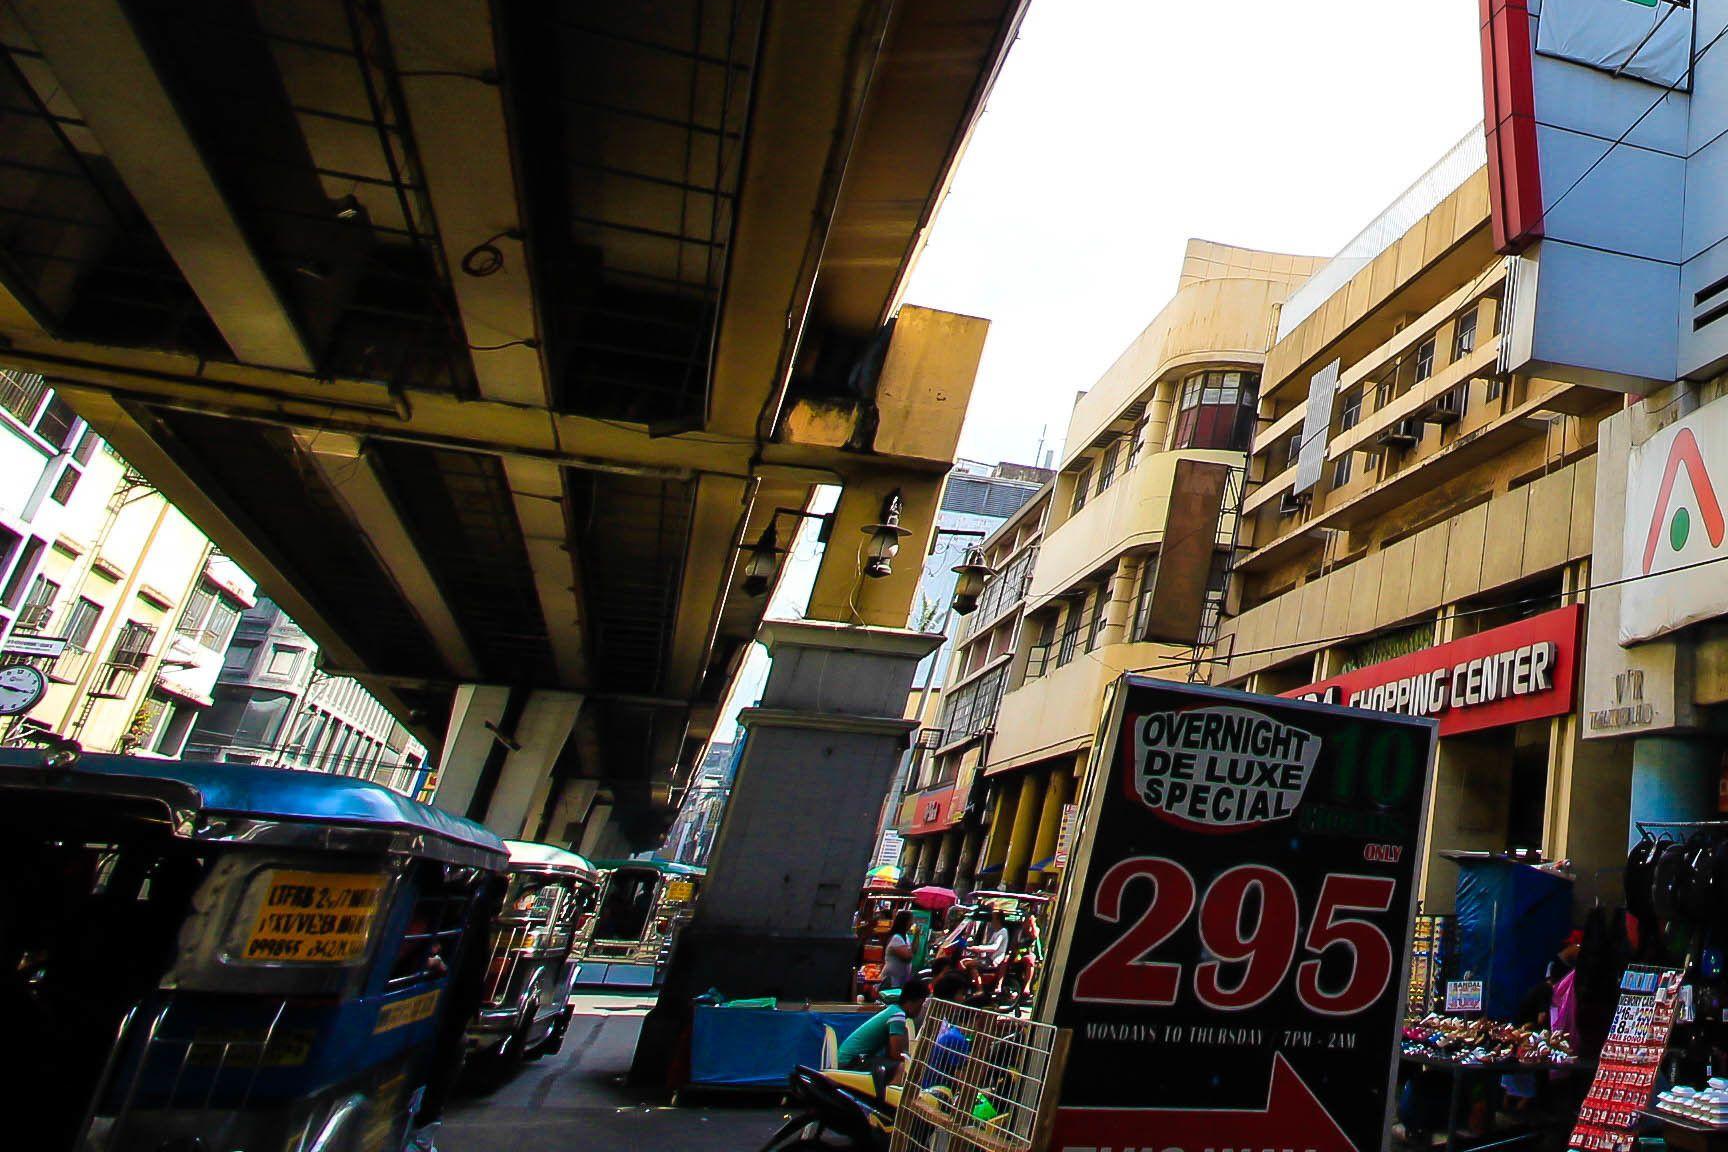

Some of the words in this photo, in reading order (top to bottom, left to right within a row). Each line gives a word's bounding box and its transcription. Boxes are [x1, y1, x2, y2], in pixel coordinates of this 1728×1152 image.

[1450, 641, 1553, 708] CENTER
[1143, 713, 1310, 762] OVERNIGHT
[1143, 749, 1197, 780] DE
[1205, 756, 1304, 791] LUXE
[1144, 778, 1291, 822] SPECIAL
[1364, 843, 1402, 862] ONLY
[1073, 855, 1396, 1016] 295
[1086, 1023, 1156, 1041] MONDAYS
[1164, 1025, 1182, 1043] TO
[1190, 1026, 1263, 1045] THURSDAY
[1283, 1030, 1312, 1047] 7PM
[1328, 1032, 1357, 1048] 2AM
